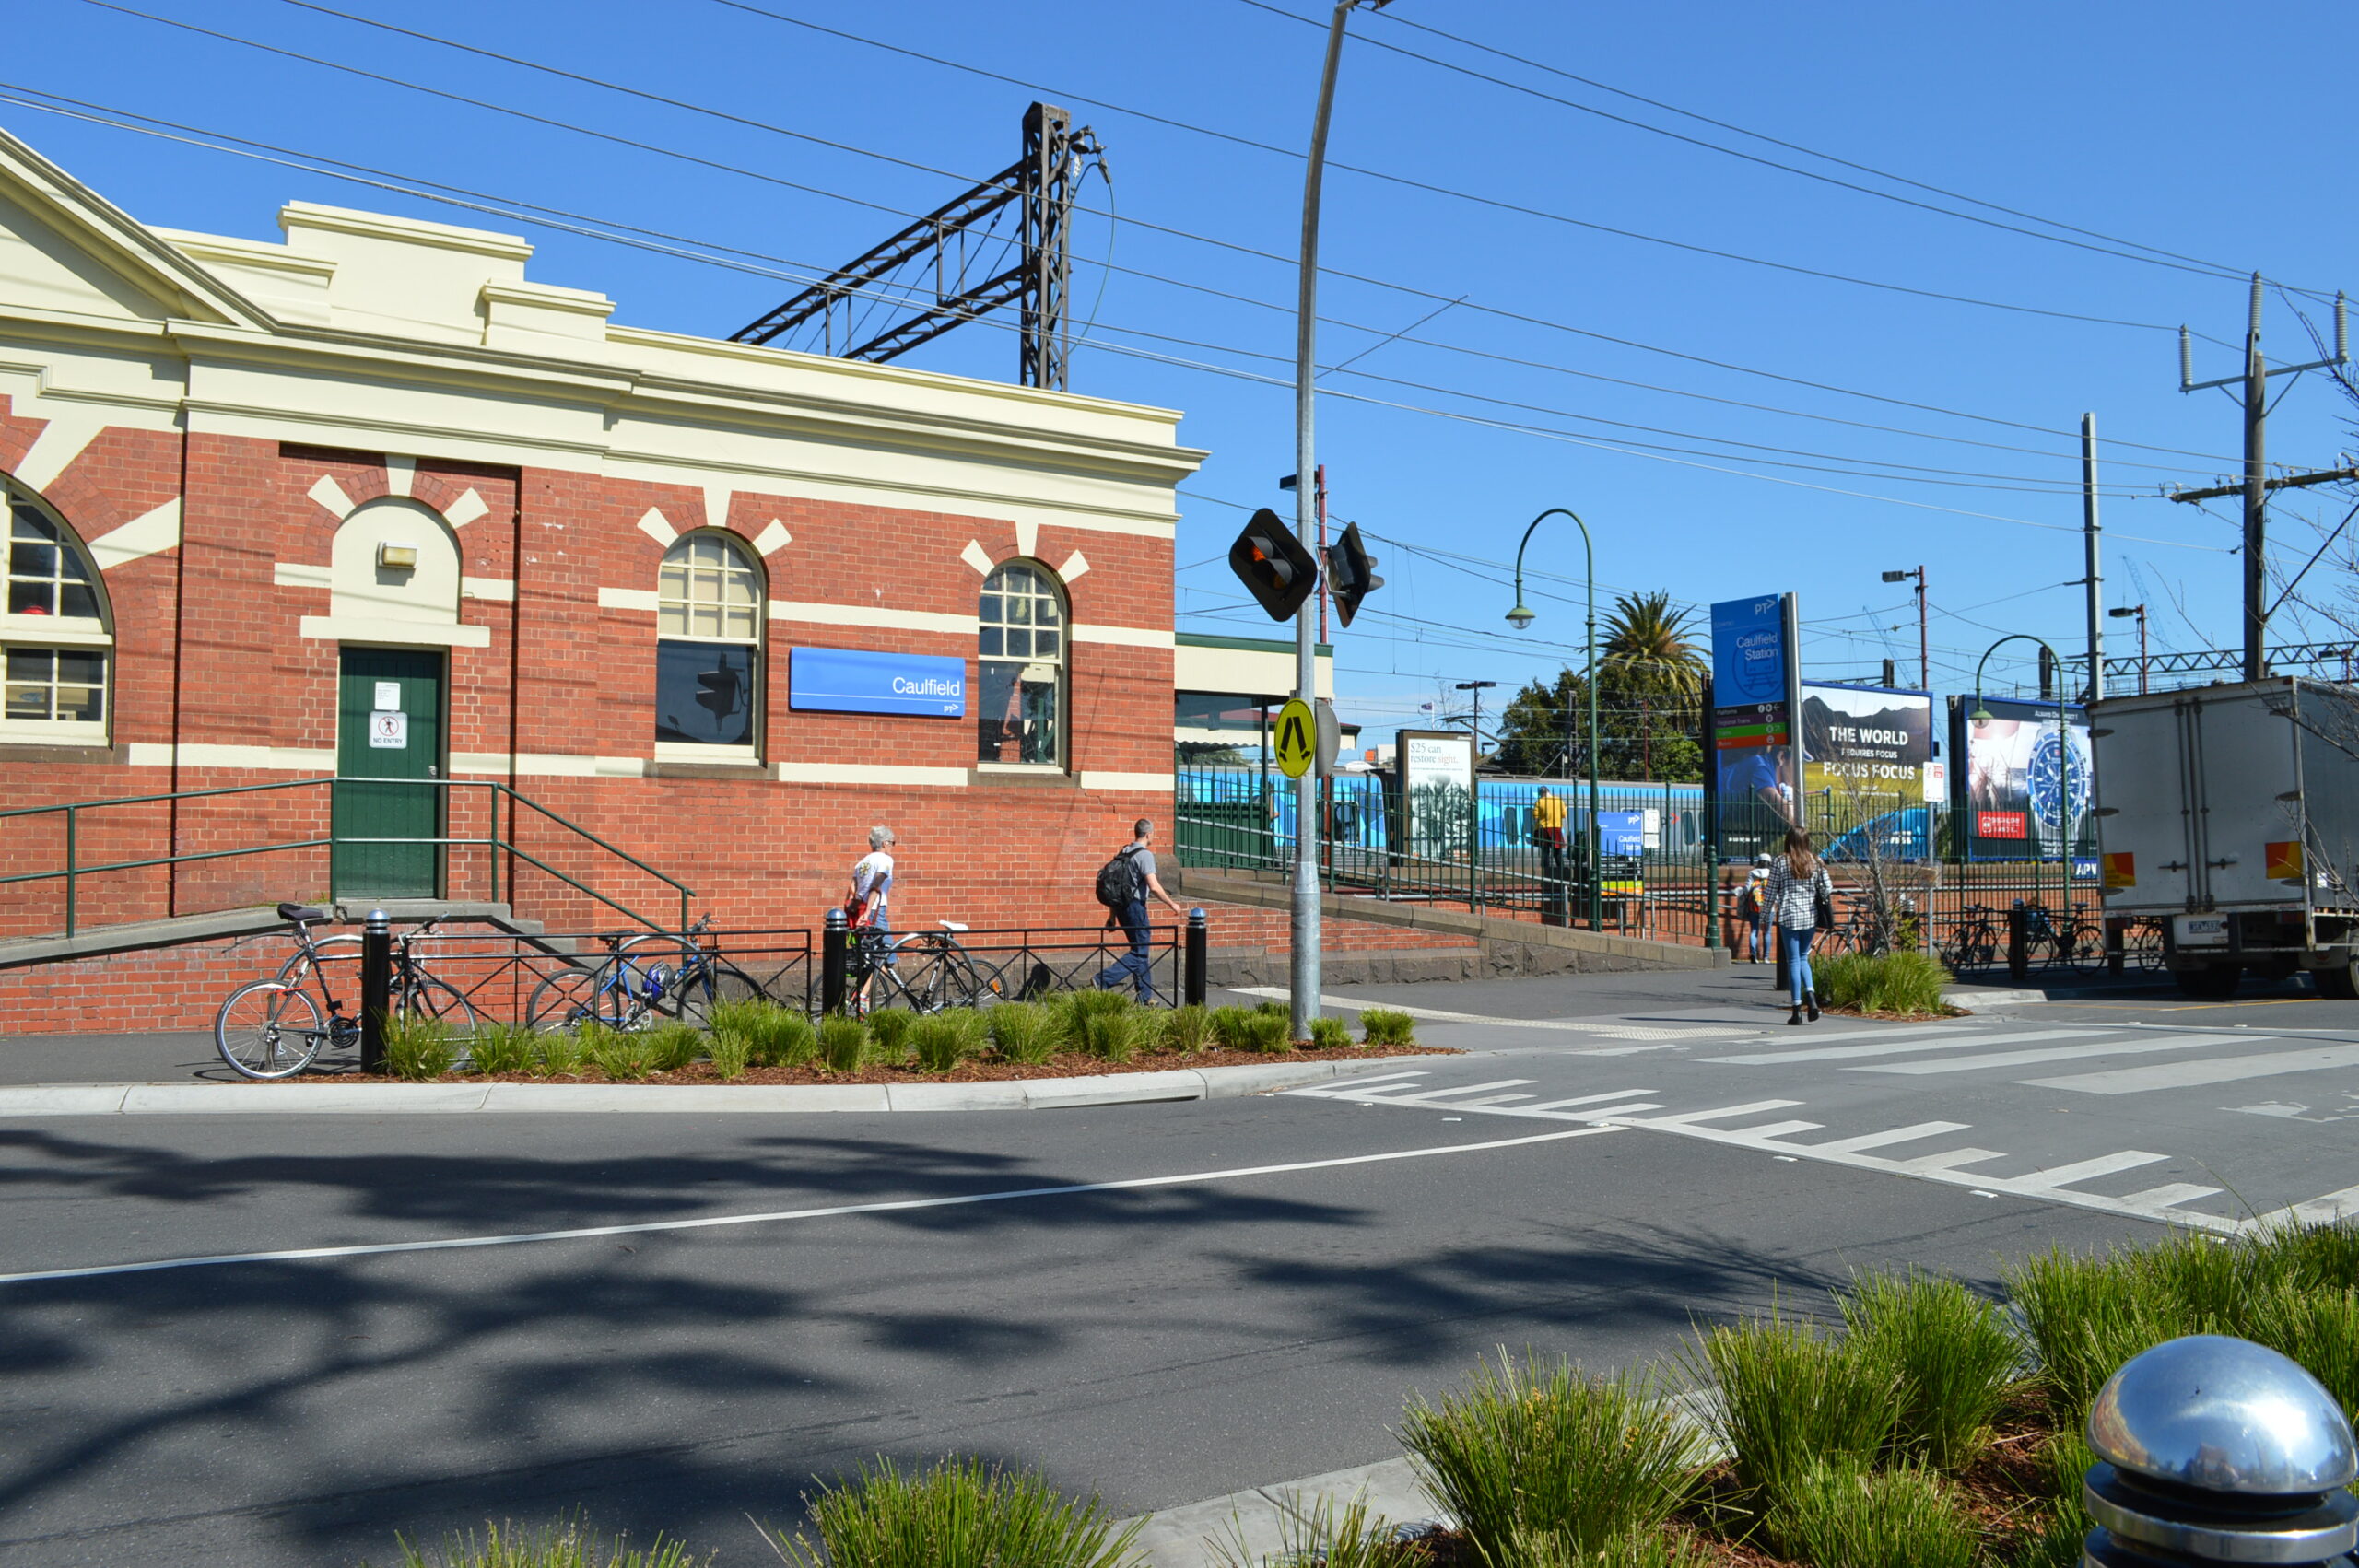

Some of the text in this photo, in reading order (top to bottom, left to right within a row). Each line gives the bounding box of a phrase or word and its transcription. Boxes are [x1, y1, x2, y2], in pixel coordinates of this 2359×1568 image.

[1736, 632, 1778, 649] Caulfield
[1744, 647, 1778, 661] Station
[892, 676, 961, 696] Caulfield
[1829, 726, 1908, 746] THE WORLD
[1410, 743, 1426, 754] $25
[1875, 750, 1898, 759] FOCUS
[1410, 753, 1460, 766] restore sight.
[1824, 761, 1869, 778] FOCUS
[1872, 764, 1916, 780] FOCUS
